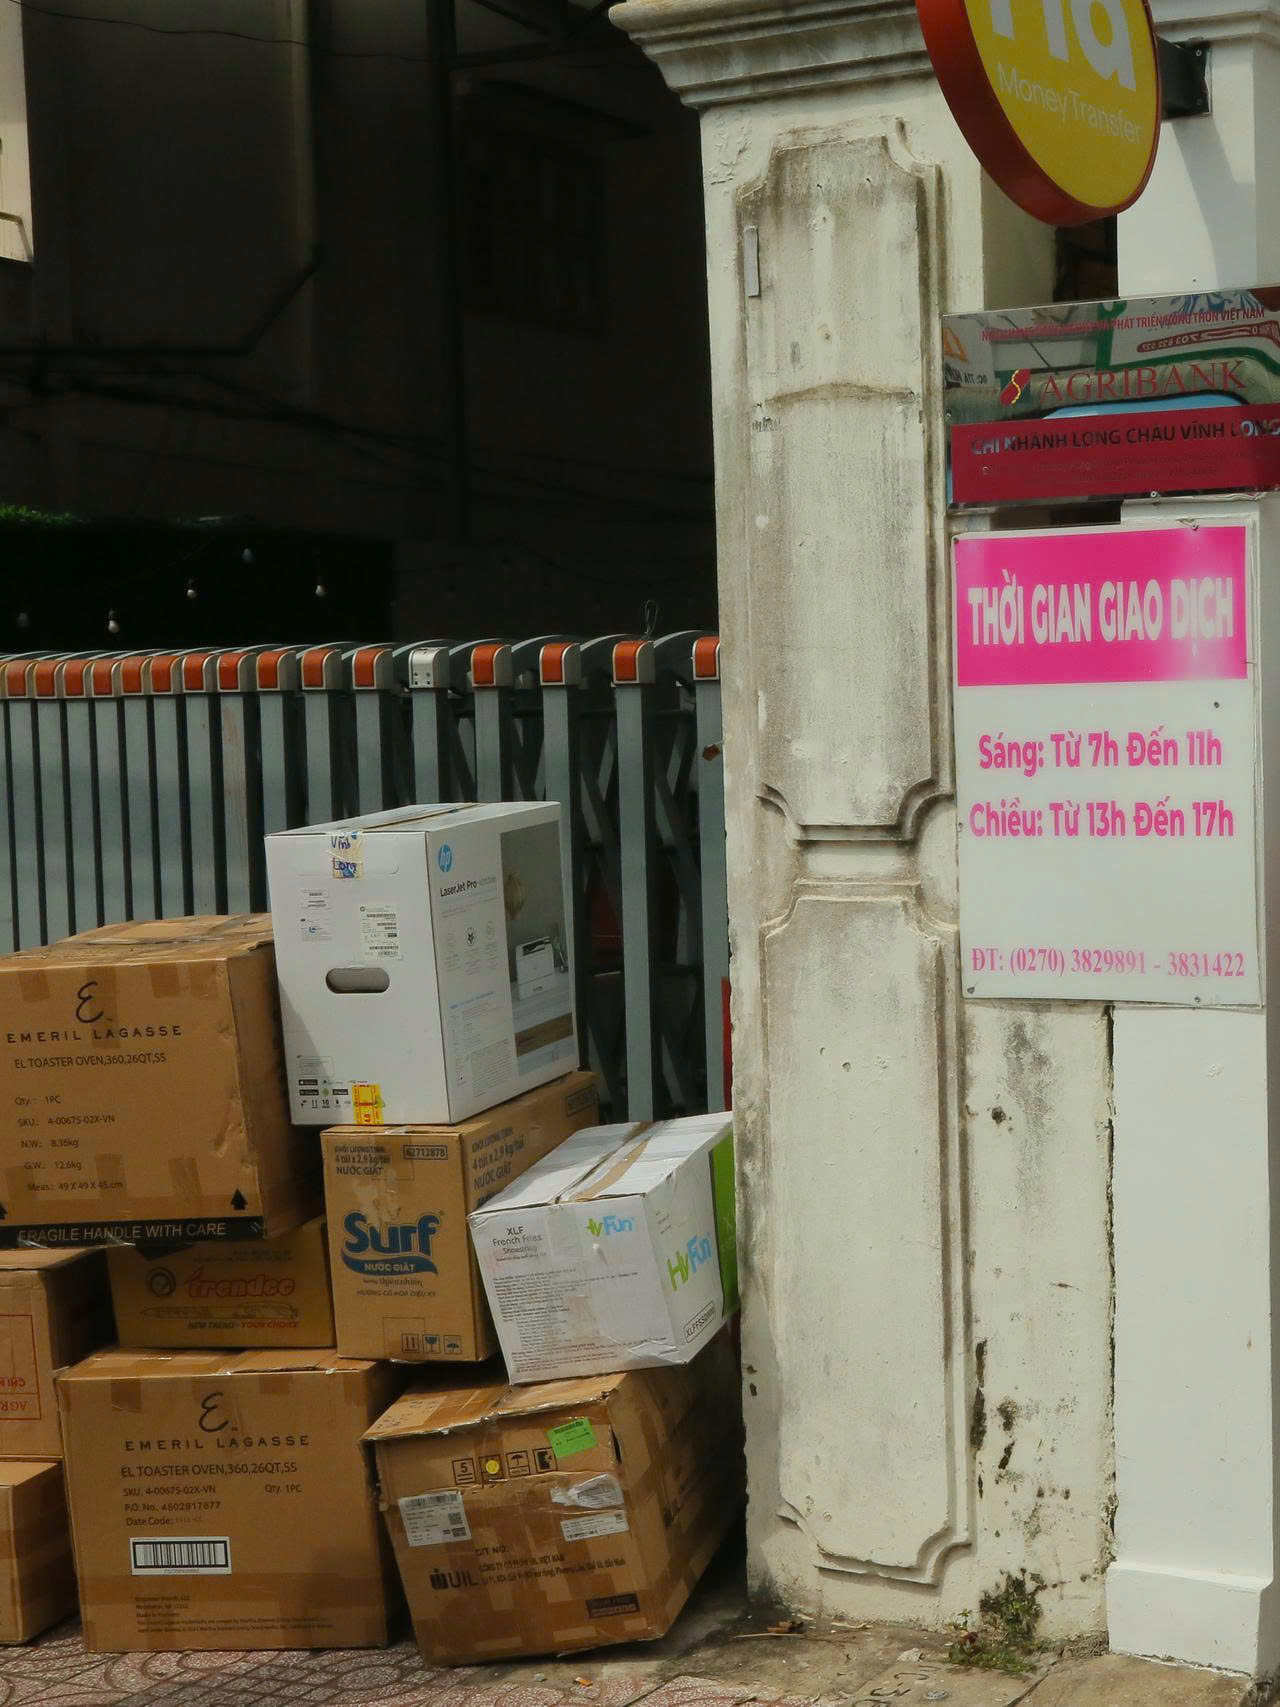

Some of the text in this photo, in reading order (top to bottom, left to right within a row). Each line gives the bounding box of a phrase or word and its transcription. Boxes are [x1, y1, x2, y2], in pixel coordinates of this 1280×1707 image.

[996, 62, 1141, 144] Money Transfer
[1242, 307, 1264, 320] NAM
[1040, 359, 1247, 404] AGRIBANK
[1073, 429, 1121, 448] LONG
[1127, 423, 1176, 444] CHÂU
[1180, 419, 1224, 441] VĨNH
[1231, 417, 1280, 438] LONG
[968, 568, 1235, 657] THỜI GIAN GIAO DỊCH
[978, 726, 1223, 778] Sáng: Từ 7h Đến 11h
[968, 795, 1235, 838] Chiều: Từ 13h Đến 17h
[439, 881, 466, 898] LaserJet
[466, 880, 477, 890] Pro
[972, 947, 1004, 972] ĐT:
[1009, 947, 1066, 978] (0270)
[1070, 949, 1146, 976] 3829891
[1167, 951, 1245, 978] 3831422
[7, 1025, 182, 1044] EMERIL LAGASSE
[15, 1058, 27, 1069] EL
[28, 1055, 73, 1069] TOASTER
[18, 1221, 227, 1243] FRAGILE HANDLE WITH CARE
[343, 1210, 440, 1257] Surf
[492, 1236, 520, 1247] French
[506, 1226, 524, 1236] XLF
[667, 1234, 713, 1292] HyFun
[125, 1435, 310, 1452] EMERIL LAGASSE
[121, 1466, 135, 1478] EL
[137, 1464, 190, 1478] TOASTER
